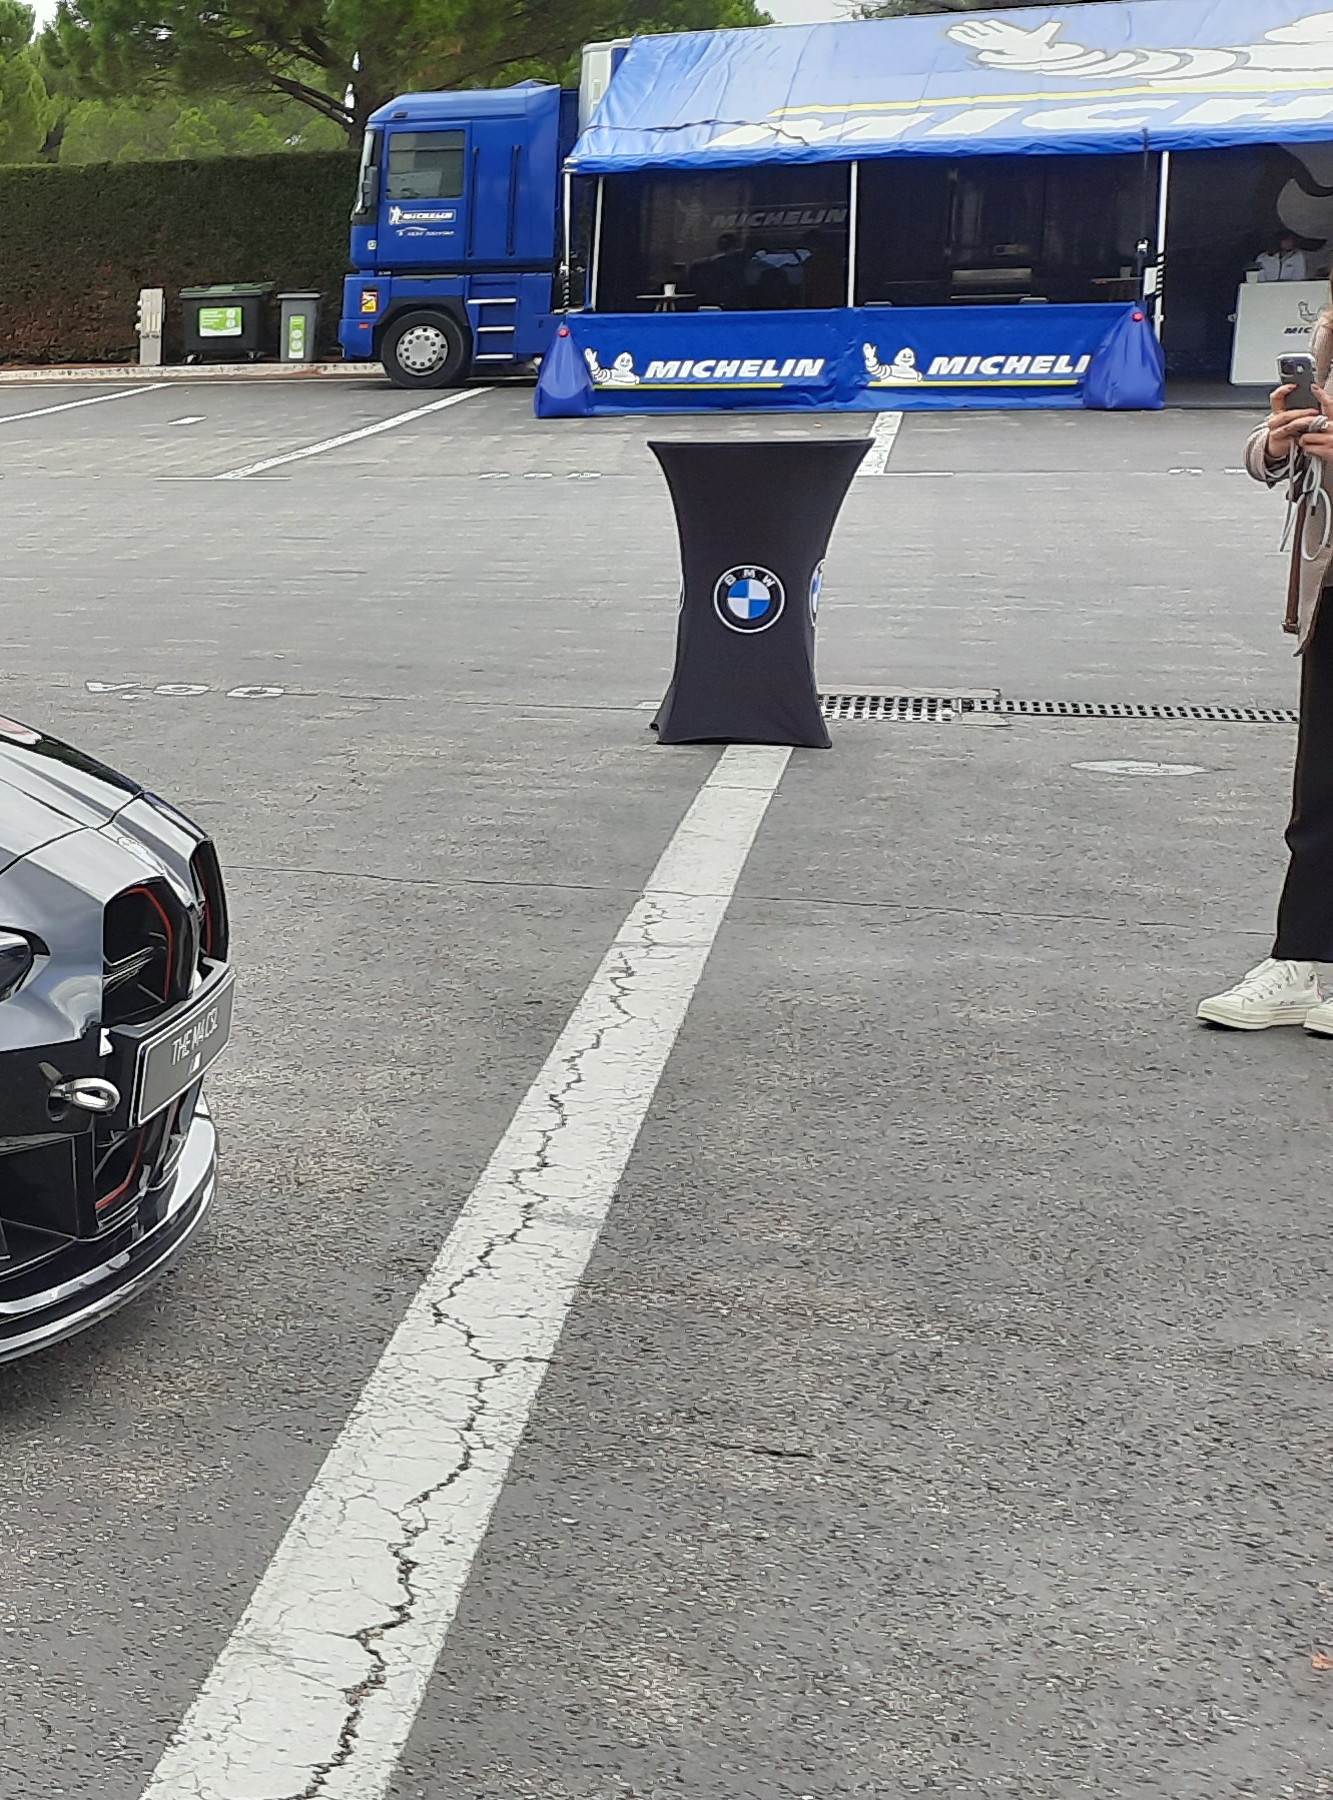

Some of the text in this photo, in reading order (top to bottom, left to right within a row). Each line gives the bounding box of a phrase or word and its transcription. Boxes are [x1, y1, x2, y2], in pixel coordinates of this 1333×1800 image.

[711, 206, 847, 229] MICHELIN
[644, 358, 825, 379] MICHELIN
[723, 569, 776, 587] BMW
